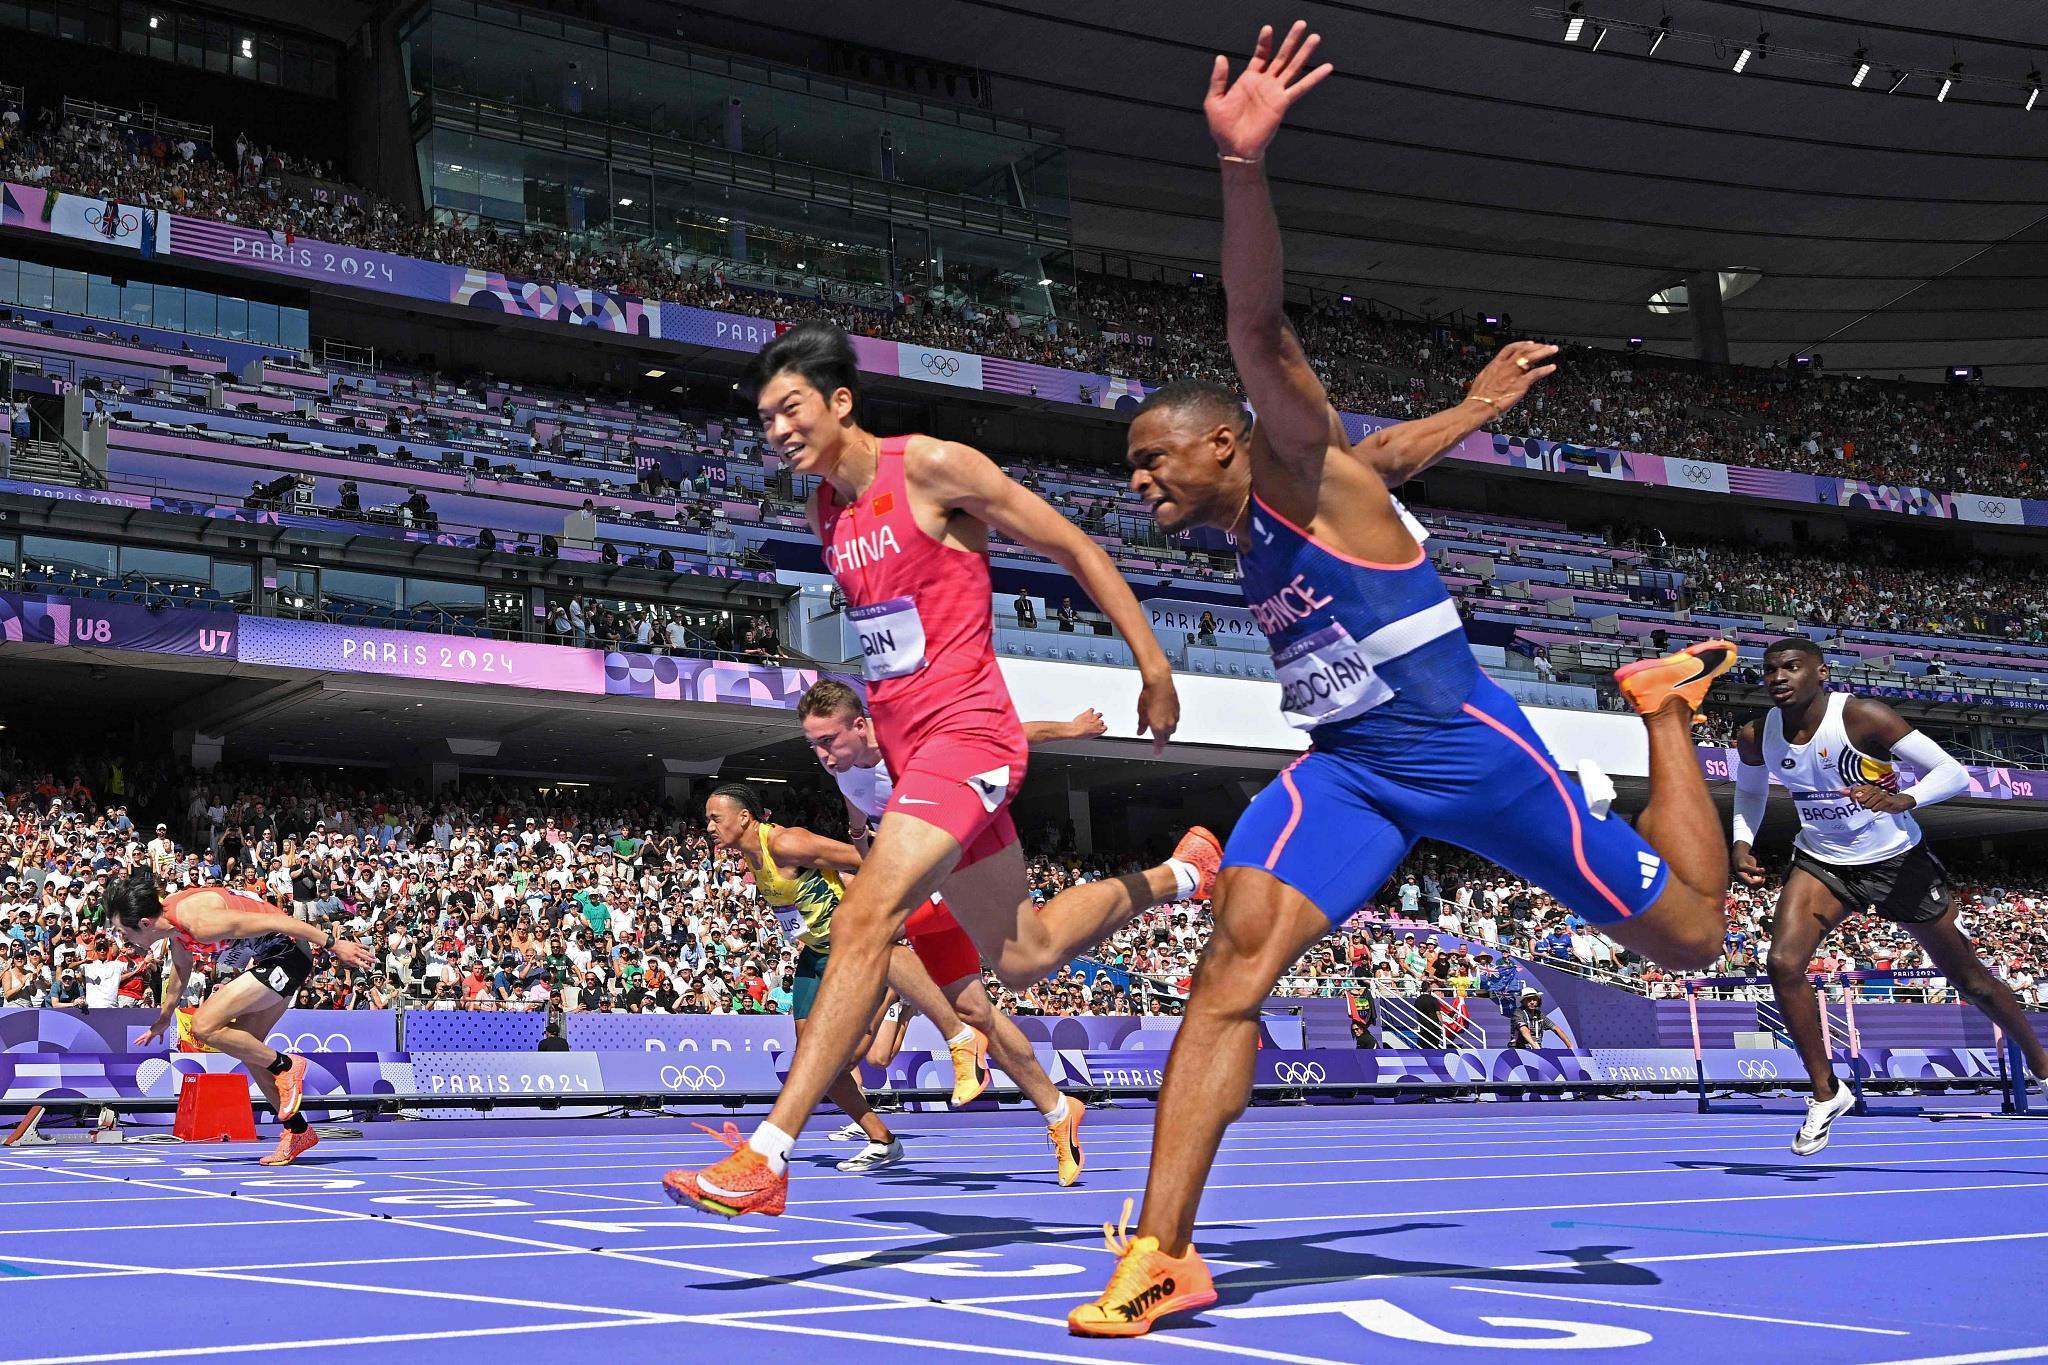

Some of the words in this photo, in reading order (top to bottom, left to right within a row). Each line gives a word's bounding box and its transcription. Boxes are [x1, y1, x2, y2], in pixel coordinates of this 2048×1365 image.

[323, 253, 394, 283] 2024
[1136, 334, 1153, 348] S17
[1409, 377, 1426, 389] S15
[0, 511, 7, 521] 6
[239, 539, 247, 549] 5
[301, 546, 308, 556] 4
[825, 524, 901, 576] CHINA
[512, 571, 518, 579] 3
[568, 577, 574, 586] 2
[1664, 588, 1677, 601] T6
[76, 617, 112, 643] U8
[199, 628, 232, 654] U7
[859, 629, 896, 657] QIN
[440, 647, 513, 674] 2024
[1705, 758, 1728, 777] S13
[2011, 781, 2033, 797] S12
[1916, 969, 1936, 977] 2024
[889, 1007, 896, 1018] 8
[519, 1073, 589, 1094] 2024
[811, 1250, 1087, 1278] 3
[1118, 1277, 1176, 1323] NITRO
[1200, 1297, 1654, 1349] 2
